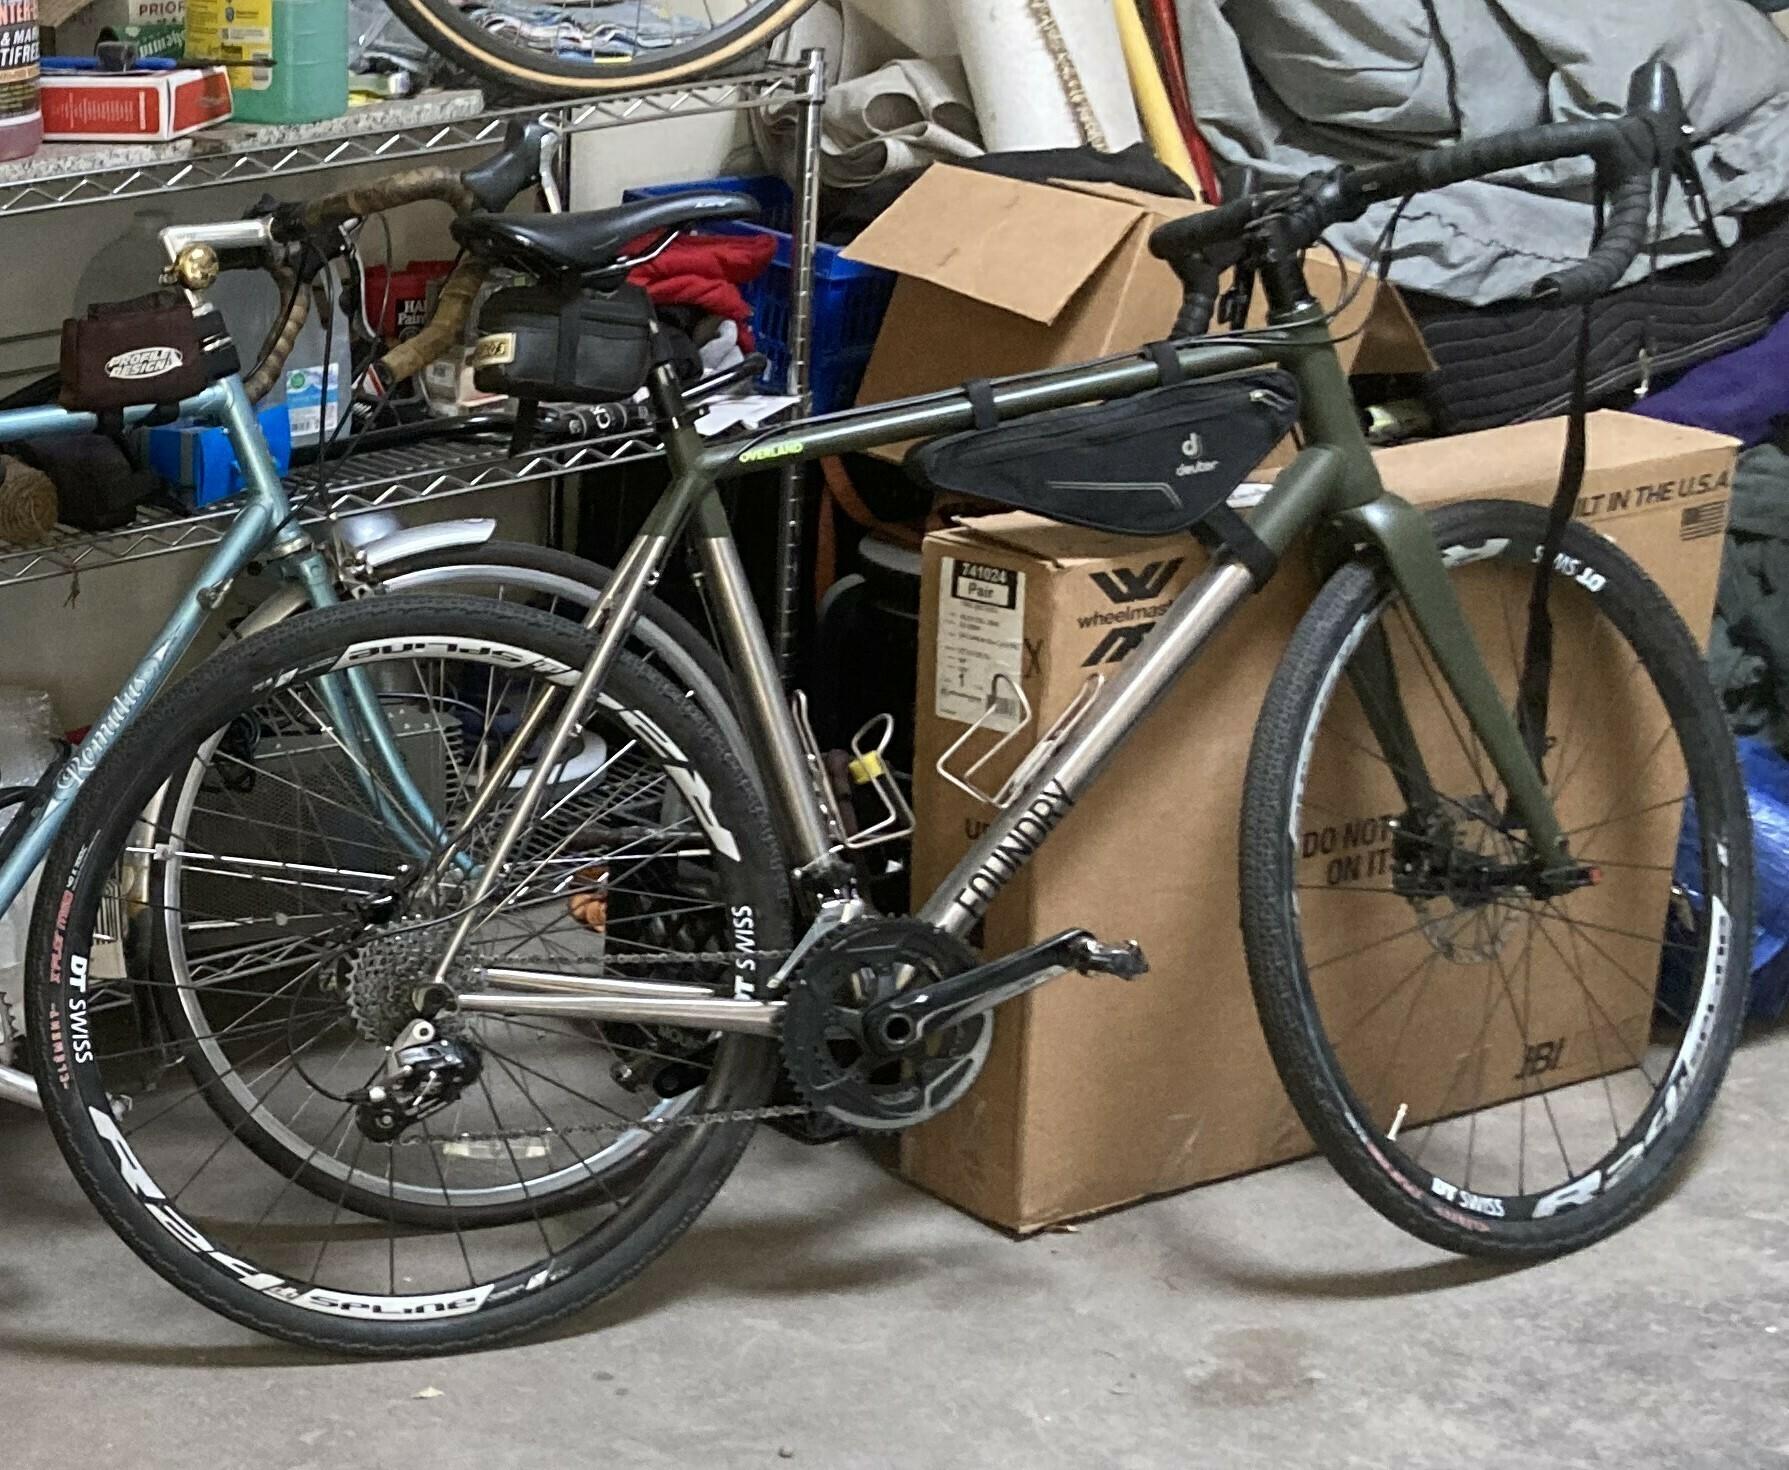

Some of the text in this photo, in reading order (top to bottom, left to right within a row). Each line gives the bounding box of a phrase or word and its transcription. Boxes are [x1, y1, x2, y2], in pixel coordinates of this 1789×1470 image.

[1176, 460, 1219, 476] deuter
[1606, 489, 1631, 512] IN
[1636, 481, 1674, 507] THE
[962, 563, 1007, 583] 741024
[968, 583, 994, 598] Pair
[1077, 599, 1173, 629] wheelmas
[953, 778, 1074, 918] FOUNDRY
[1302, 814, 1391, 858] DO NOT
[1326, 854, 1361, 885] ON
[731, 905, 756, 971] SWISS
[69, 954, 94, 1064] DT SWISS
